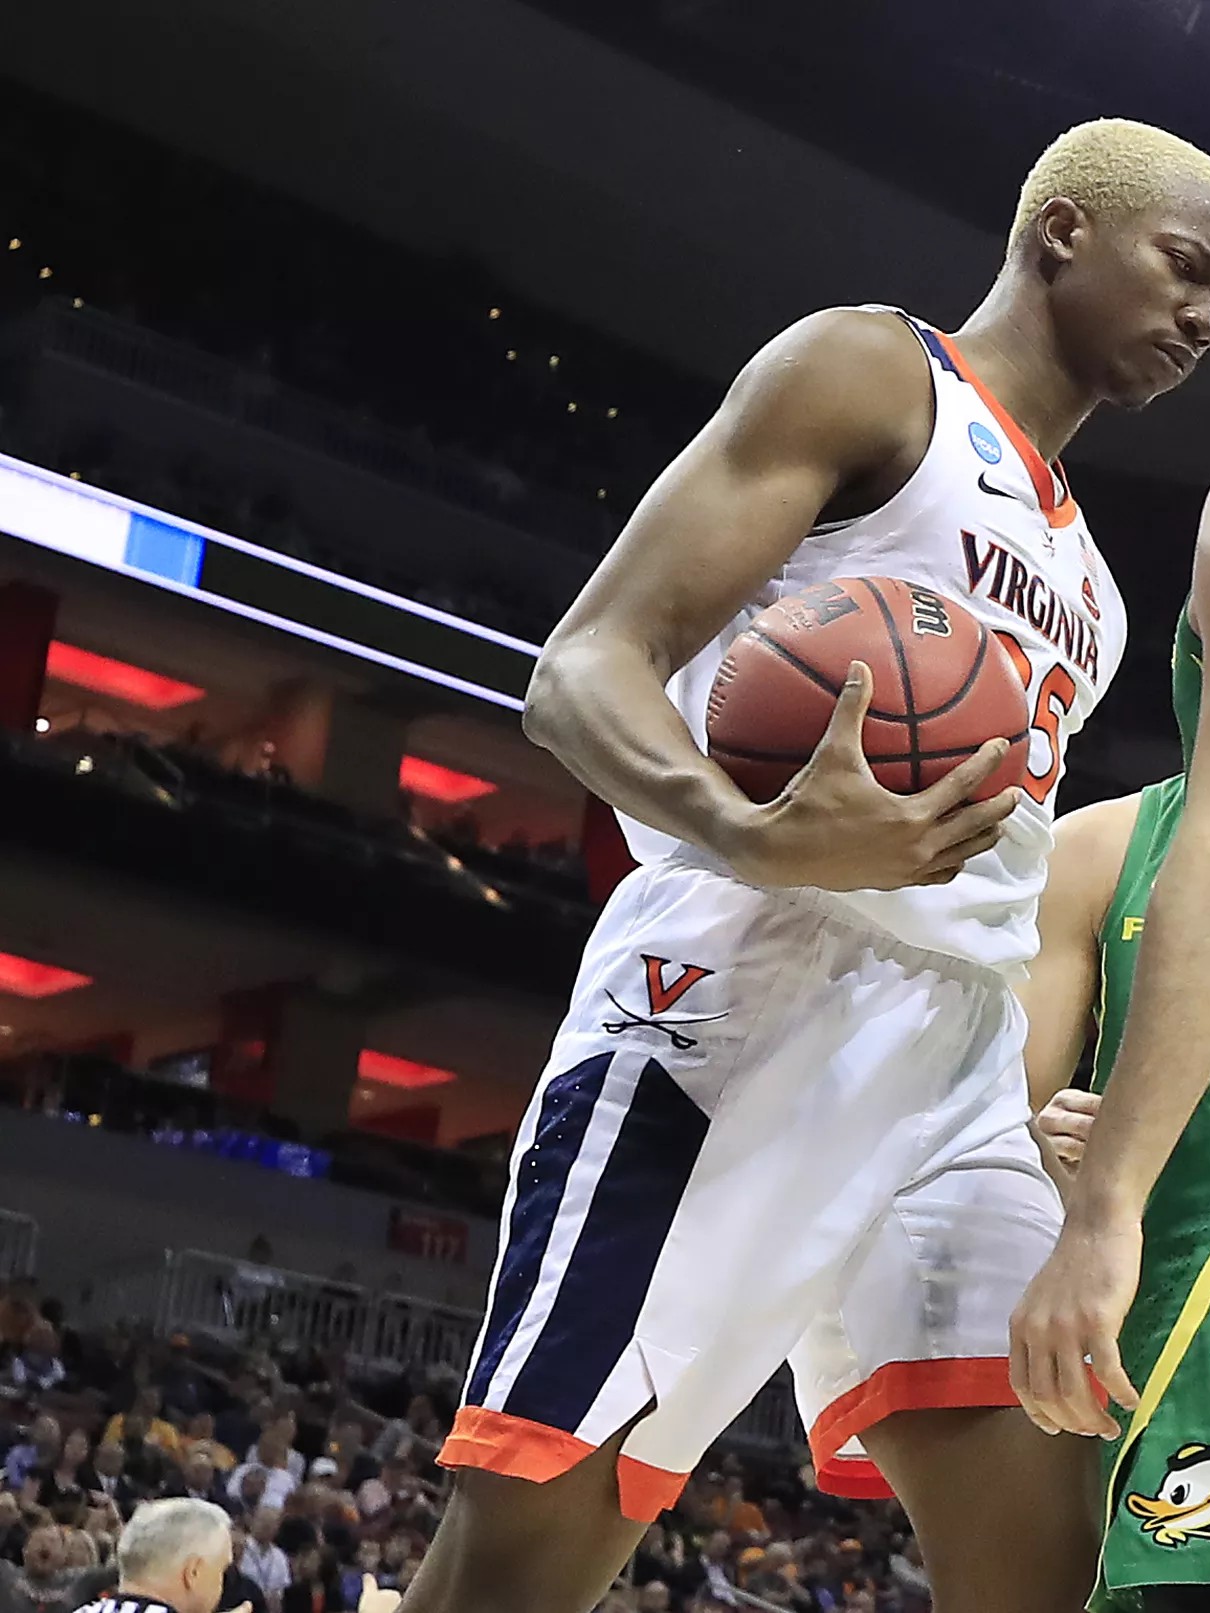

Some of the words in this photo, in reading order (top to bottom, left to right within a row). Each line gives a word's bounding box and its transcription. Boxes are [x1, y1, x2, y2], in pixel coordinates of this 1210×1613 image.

[960, 529, 1099, 685] VIRGINIA
[994, 629, 1075, 804] 5
[640, 953, 715, 1016] V
